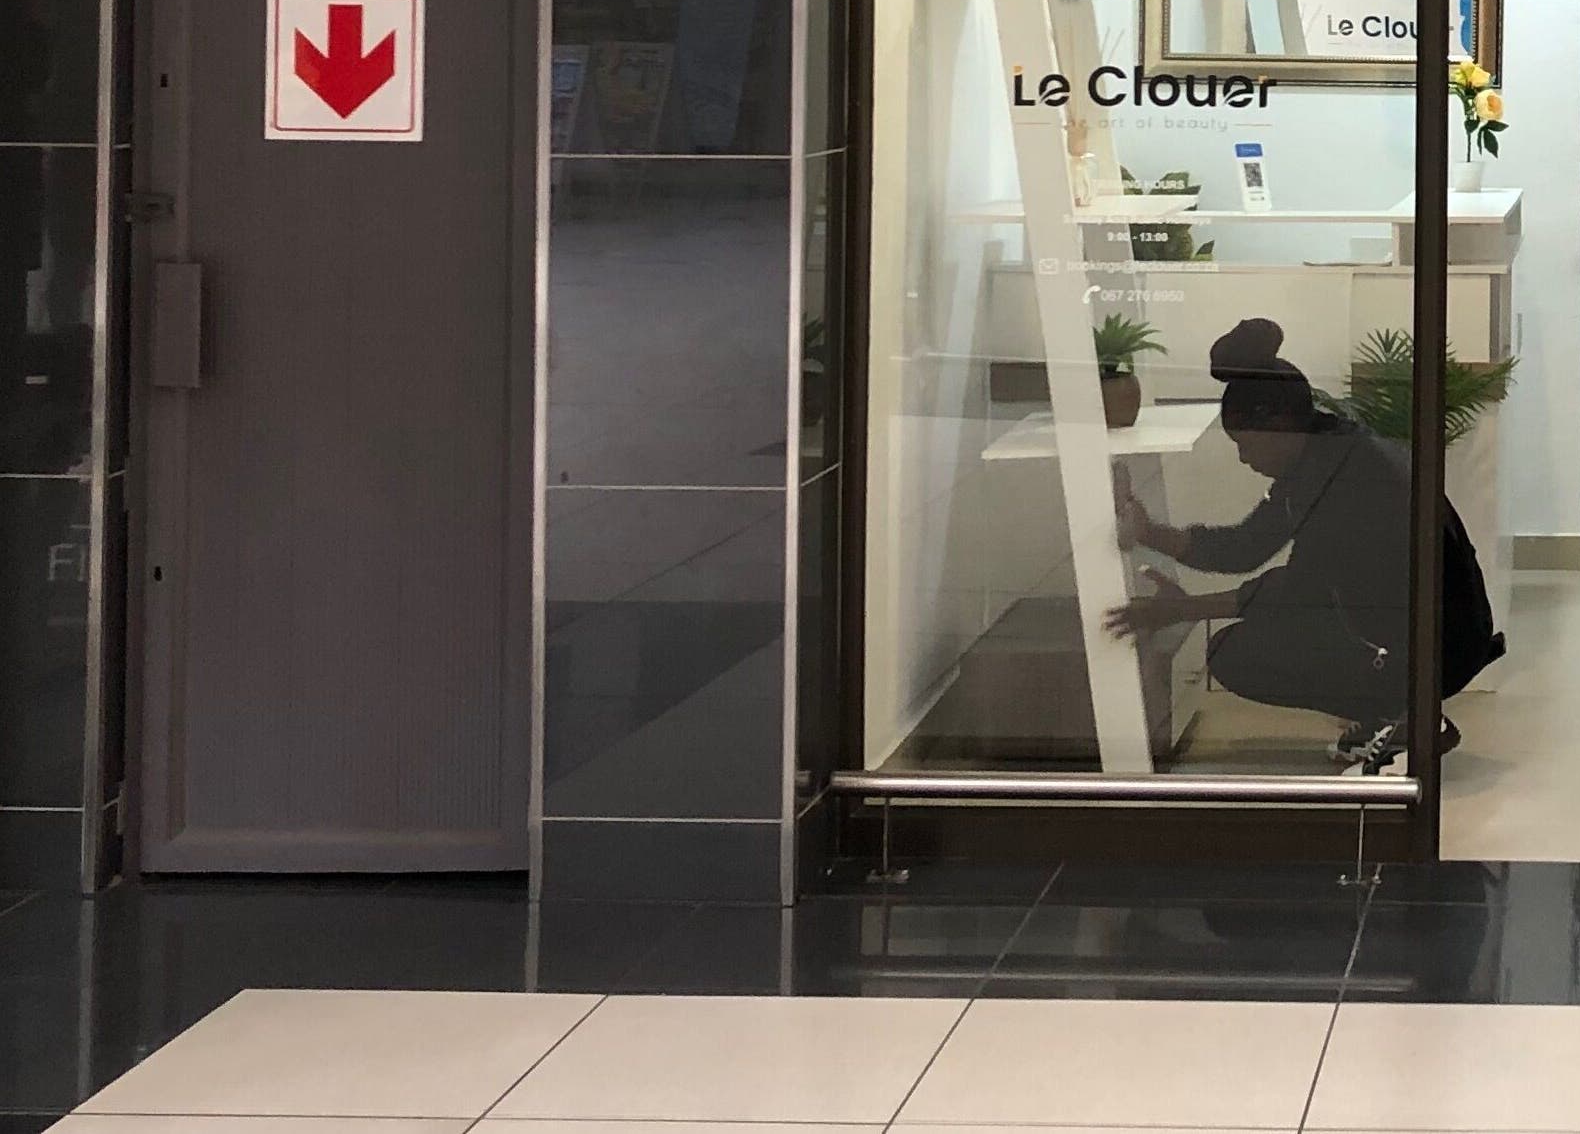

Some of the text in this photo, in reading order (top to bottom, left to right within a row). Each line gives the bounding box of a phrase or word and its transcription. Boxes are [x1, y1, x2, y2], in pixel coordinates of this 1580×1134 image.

[1014, 66, 1277, 107] Le Clouer
[1164, 119, 1227, 132] beauty
